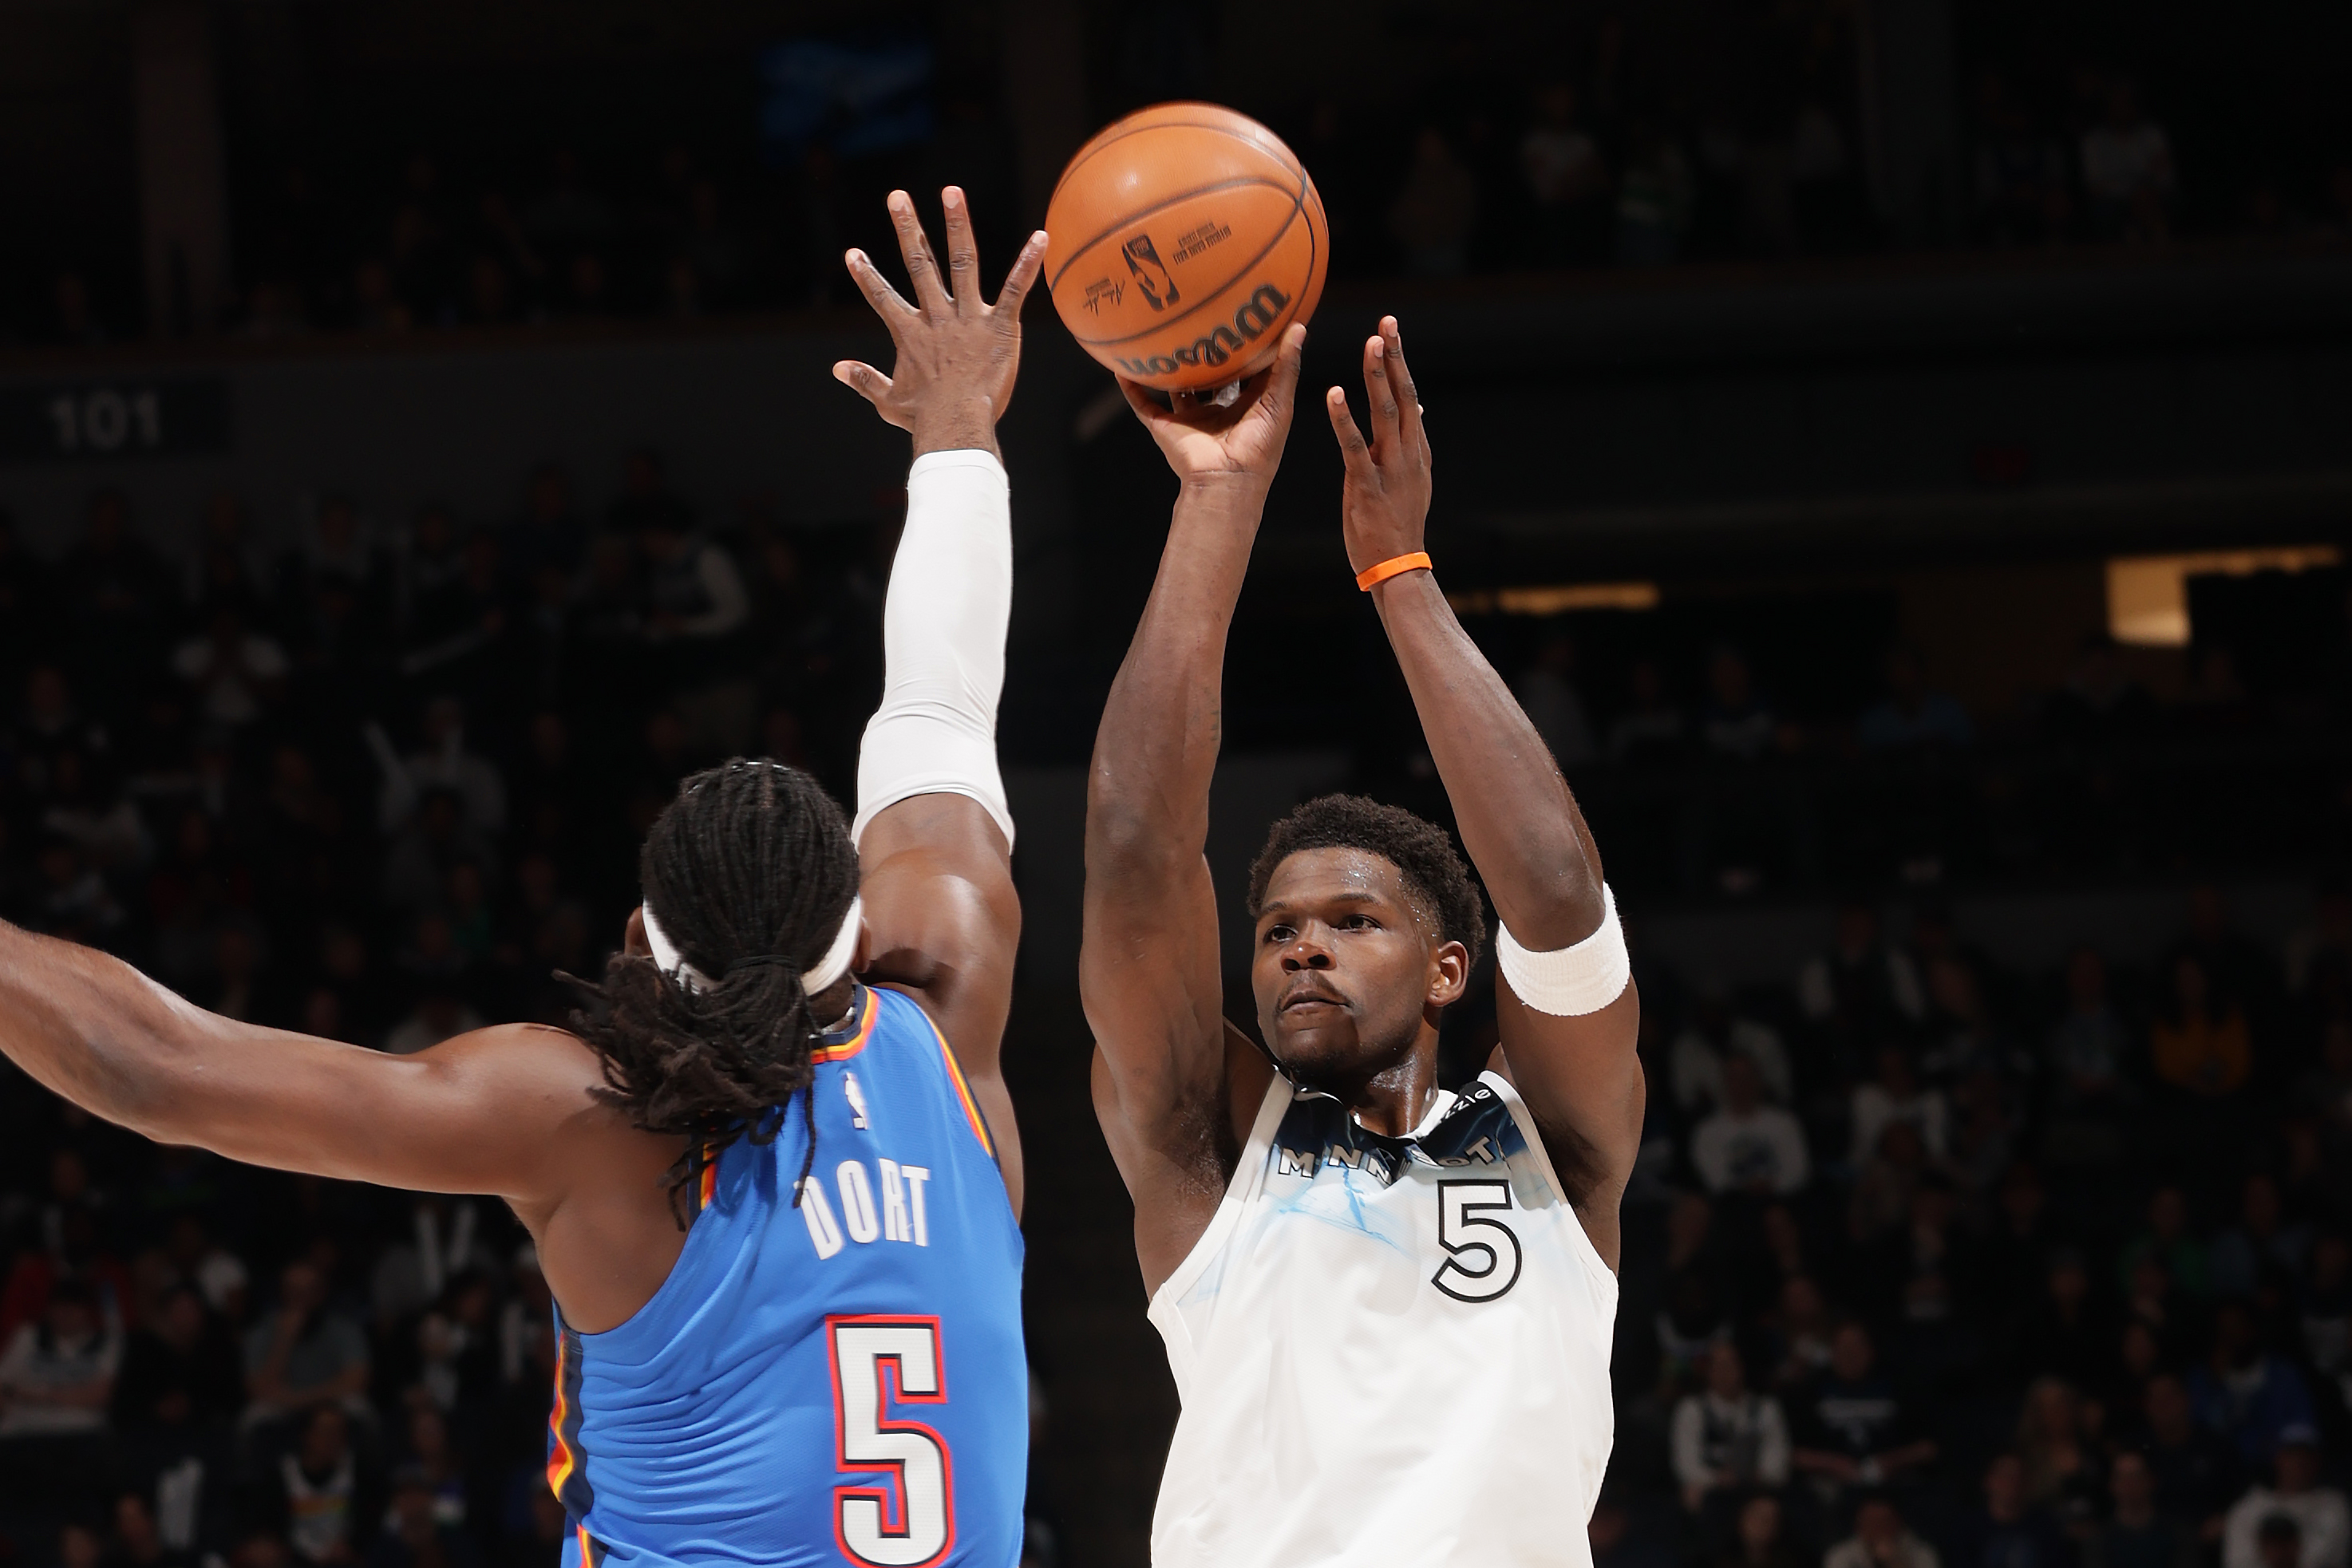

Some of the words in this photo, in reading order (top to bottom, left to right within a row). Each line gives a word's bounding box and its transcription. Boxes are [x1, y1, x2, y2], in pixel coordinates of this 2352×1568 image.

[1115, 282, 1293, 375] Wilson
[48, 389, 160, 452] 101
[793, 1157, 931, 1261] DORT
[1431, 1179, 1523, 1304] 5
[825, 1314, 958, 1568] 5
